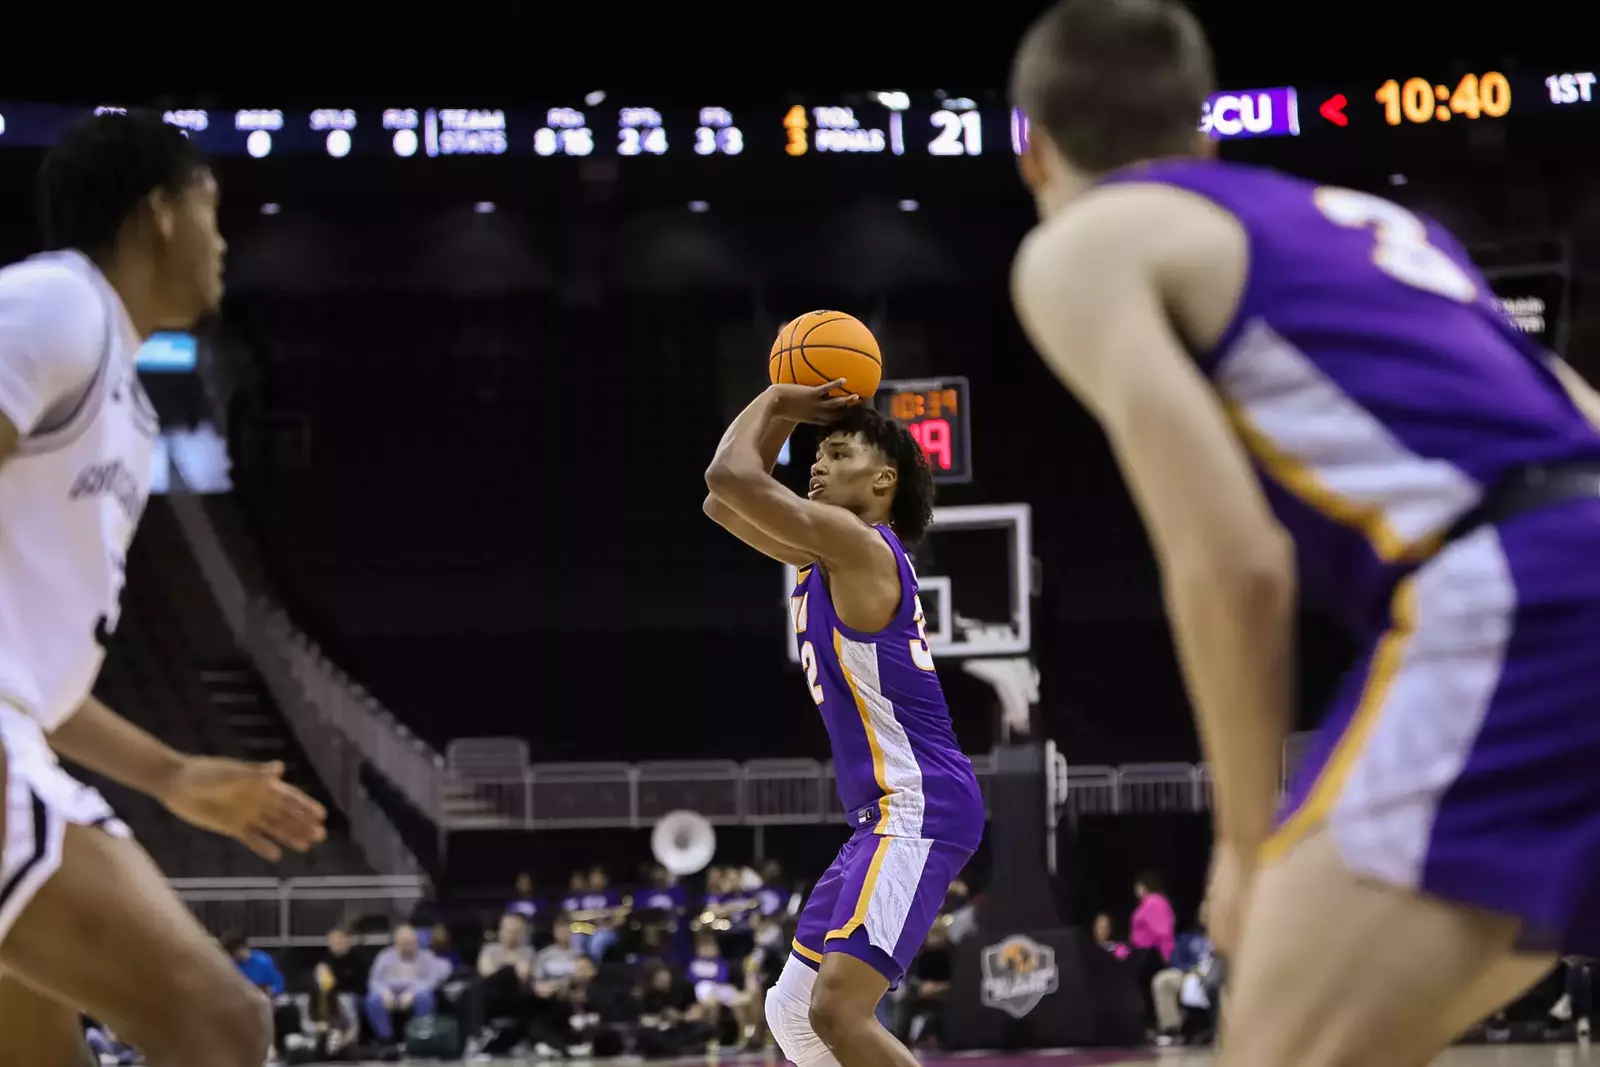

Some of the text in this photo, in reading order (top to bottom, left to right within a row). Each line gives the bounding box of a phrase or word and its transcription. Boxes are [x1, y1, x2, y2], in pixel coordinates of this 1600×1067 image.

[1375, 71, 1511, 126] 10:40
[1545, 72, 1597, 104] 1ST
[928, 109, 982, 155] 21
